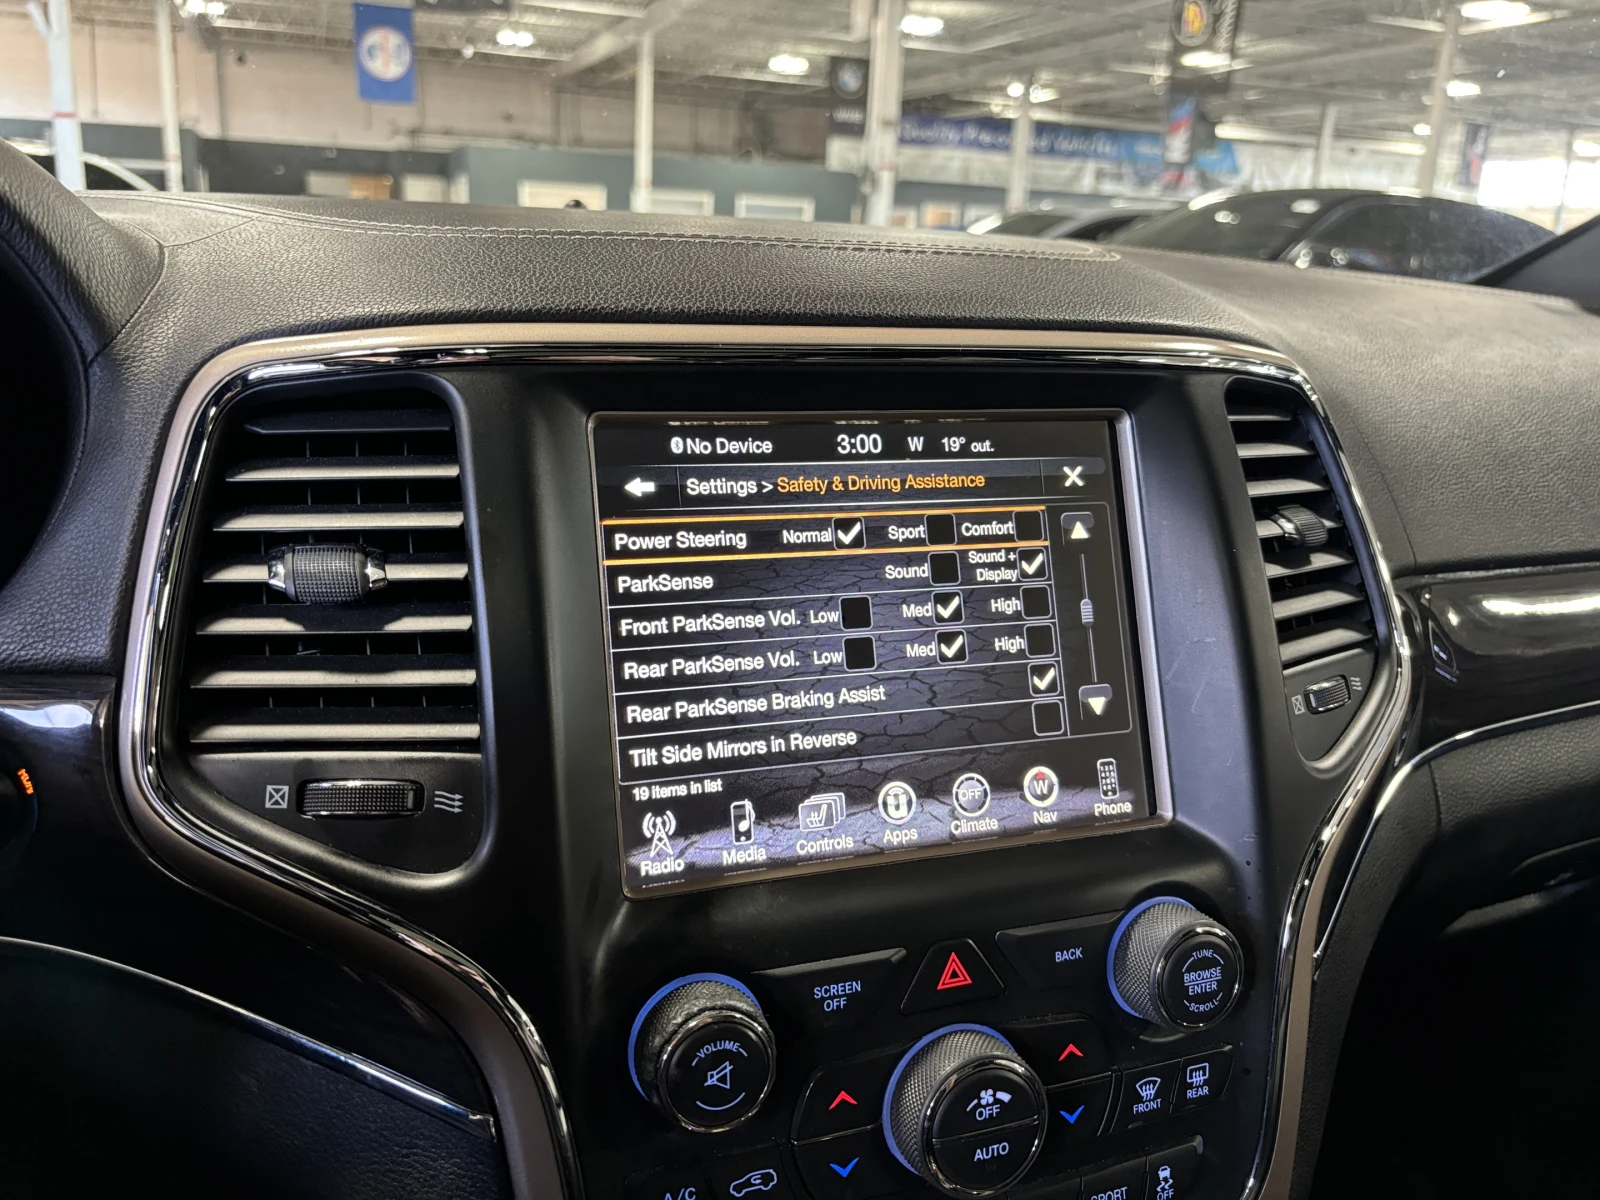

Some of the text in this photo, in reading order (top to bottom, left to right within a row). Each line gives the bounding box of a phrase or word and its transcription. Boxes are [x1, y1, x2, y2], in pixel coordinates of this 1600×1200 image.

[686, 437, 773, 454] No Device
[836, 433, 883, 454] 3:00
[907, 436, 924, 451] W
[941, 437, 995, 453] 19° out.
[686, 478, 758, 497] Settings
[776, 476, 828, 495] Safety
[832, 475, 845, 491] &
[847, 473, 901, 492] Driving
[905, 472, 986, 489] Assistance
[782, 528, 832, 544] Normal
[888, 525, 925, 541] Sport
[961, 521, 1014, 537] Comfort
[614, 531, 747, 551] Power Steering
[968, 550, 1006, 564] Sound
[885, 564, 929, 579] Sound
[976, 567, 1018, 583] Display
[617, 574, 714, 594] ParkSense
[902, 603, 933, 619] Med
[991, 597, 1021, 614] High
[620, 609, 801, 637] Front ParkSense Vol.
[809, 610, 840, 625] Low
[906, 642, 936, 657] Med
[994, 636, 1025, 652] High
[623, 650, 800, 680] Rear ParkSense Vol.
[813, 651, 843, 665] Low
[626, 684, 886, 724] Rear ParkSense Braking Assist
[628, 731, 858, 768] Tilt Side Mirrors in Reverse
[632, 779, 723, 801] 19 items in list
[959, 787, 982, 801] OFF
[1033, 780, 1049, 796] W
[1094, 800, 1133, 816] Phone
[1033, 809, 1058, 824] Nav
[950, 817, 999, 835] Climate
[883, 827, 919, 845] Apps
[796, 834, 855, 855] Controls
[722, 846, 767, 866] Media
[640, 858, 685, 877] Radio
[1055, 947, 1084, 963] BACK
[1191, 948, 1214, 960] TUNE
[1183, 966, 1222, 983] BROWSE
[813, 980, 862, 999] SCREEN
[1188, 980, 1218, 996] ENTER
[823, 997, 848, 1012] OFF
[1188, 1000, 1219, 1013] SCROLL
[697, 1040, 739, 1059] VOLUME
[1186, 1085, 1209, 1099] REAR
[975, 1105, 1001, 1121] OFF
[1133, 1098, 1162, 1114] FRONT
[973, 1142, 1009, 1162] AUTO
